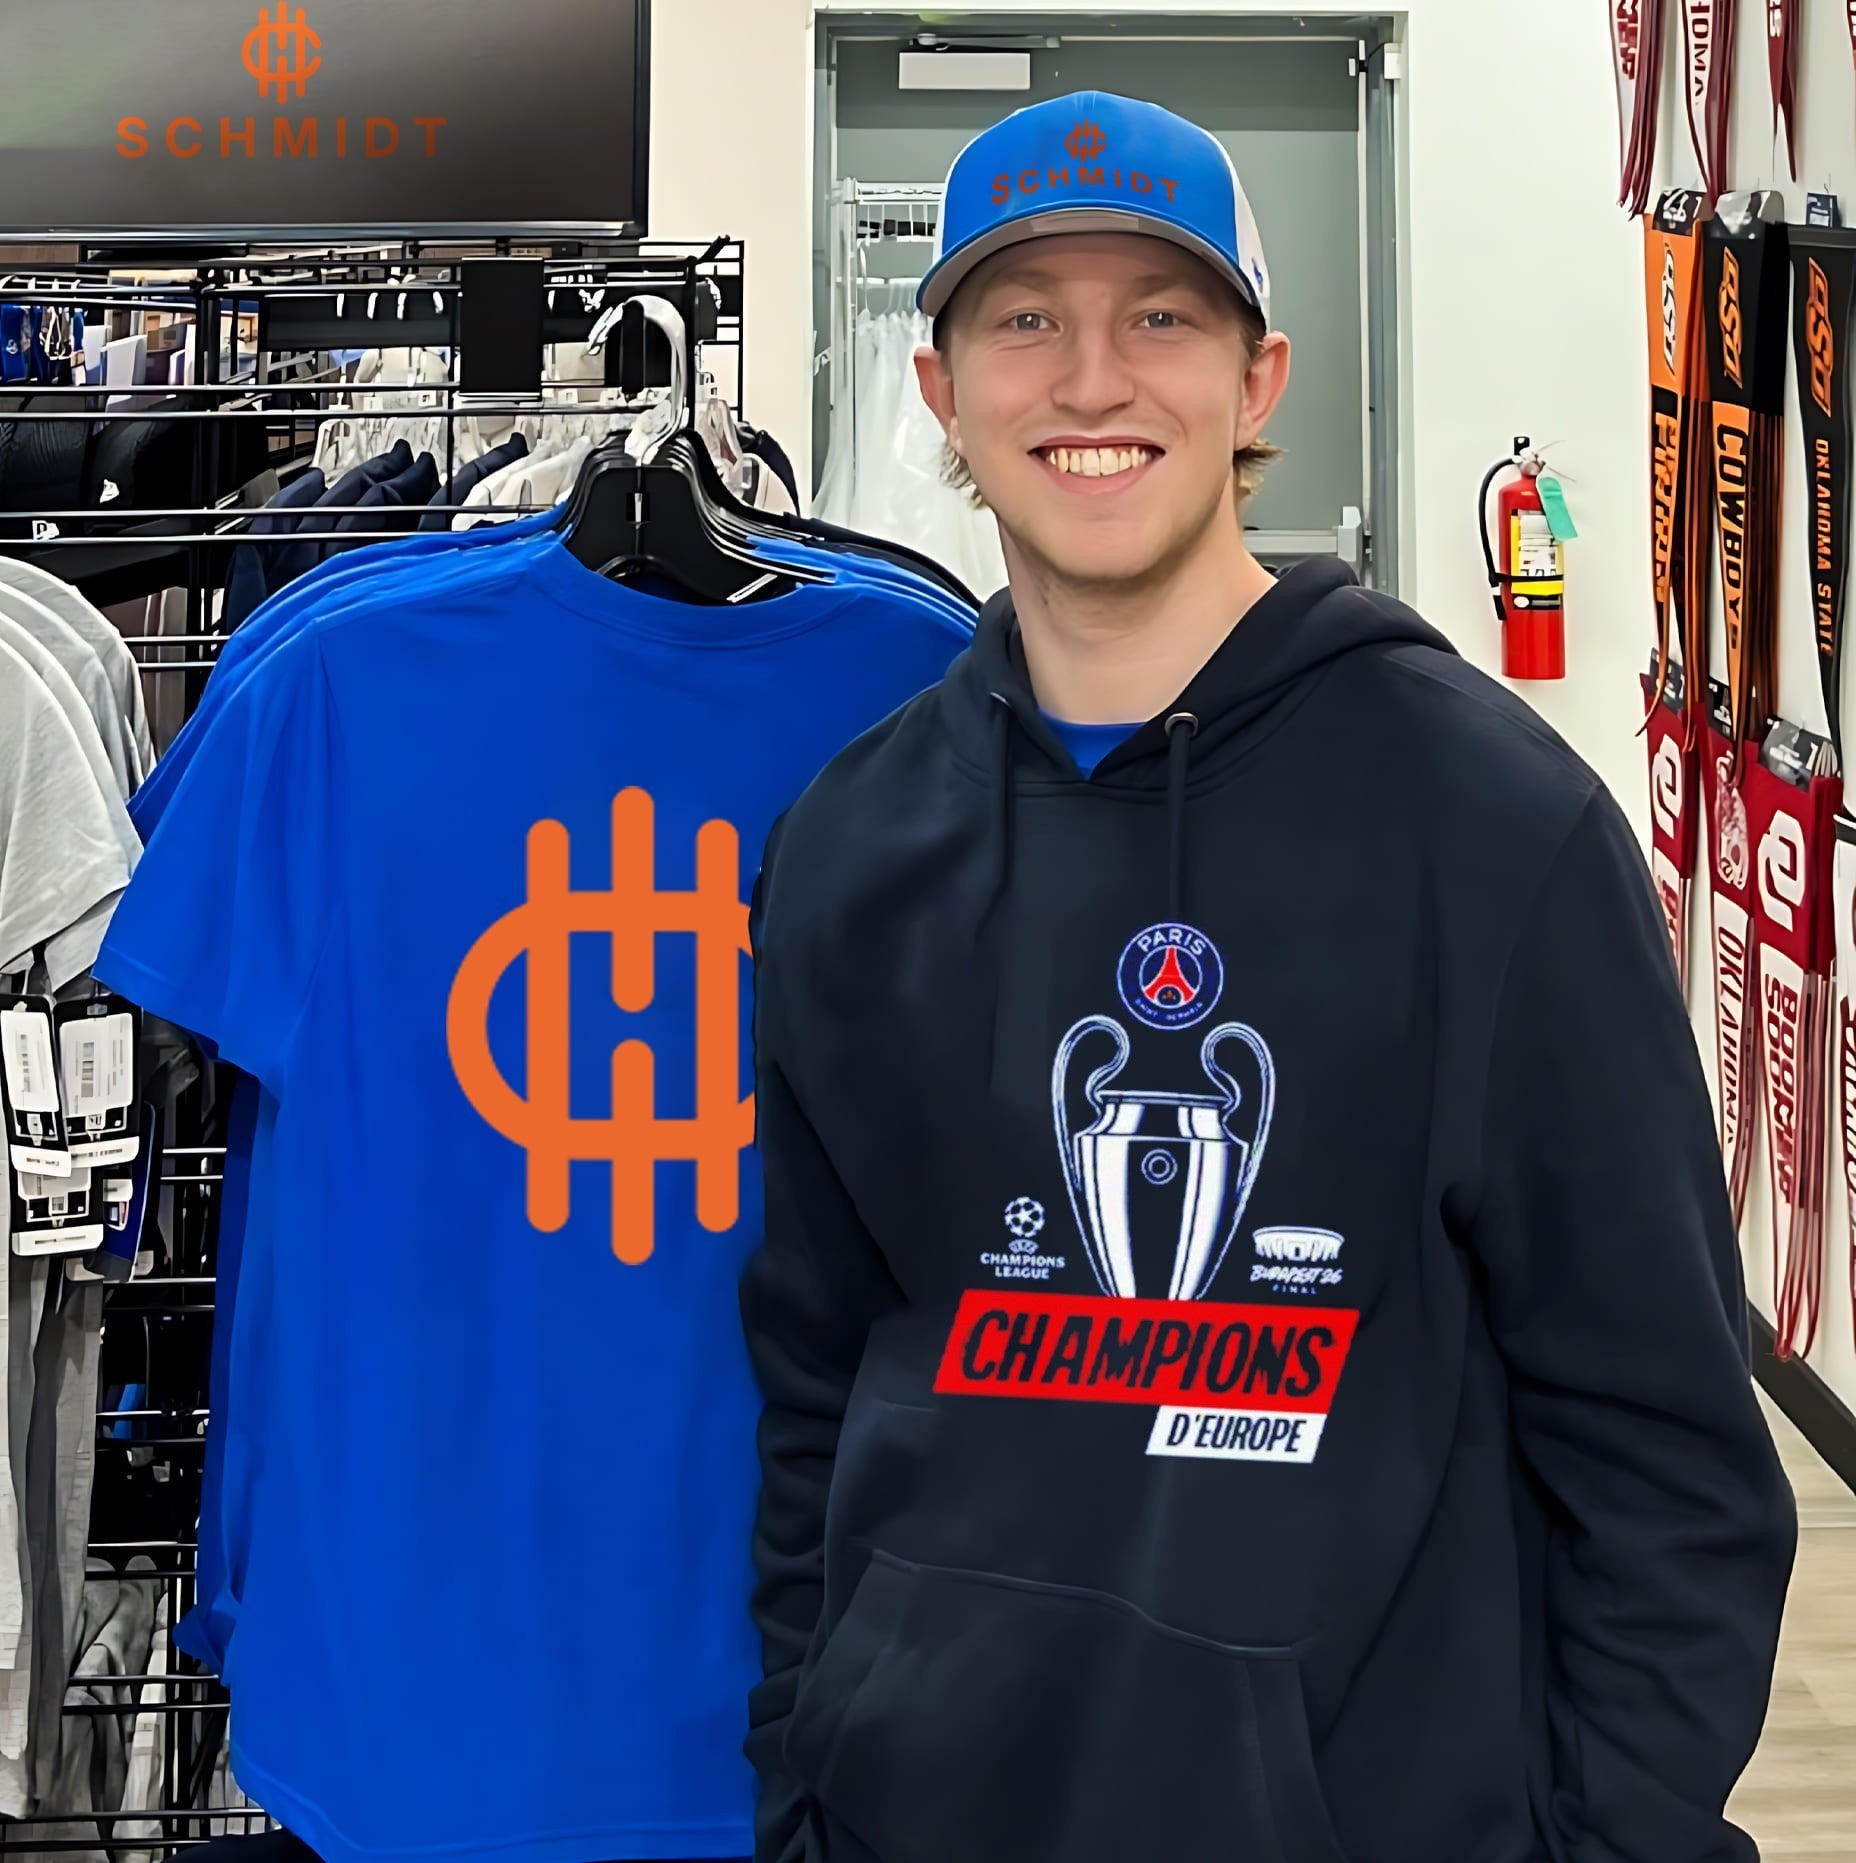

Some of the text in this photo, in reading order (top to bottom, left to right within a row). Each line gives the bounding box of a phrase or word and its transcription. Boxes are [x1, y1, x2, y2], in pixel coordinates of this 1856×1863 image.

[115, 116, 447, 158] SCHMIDT
[992, 167, 1178, 204] SCHMIDT
[1815, 438, 1832, 570] OKLAHOMA
[1137, 928, 1207, 955] PARIS
[980, 1252, 1066, 1268] CHAMPIONS
[995, 1266, 1050, 1279] LEAGUE
[1272, 1284, 1317, 1295] FINAL
[962, 1308, 1335, 1398] CHAMPIONS
[1167, 1413, 1307, 1453] D'EUROPE
